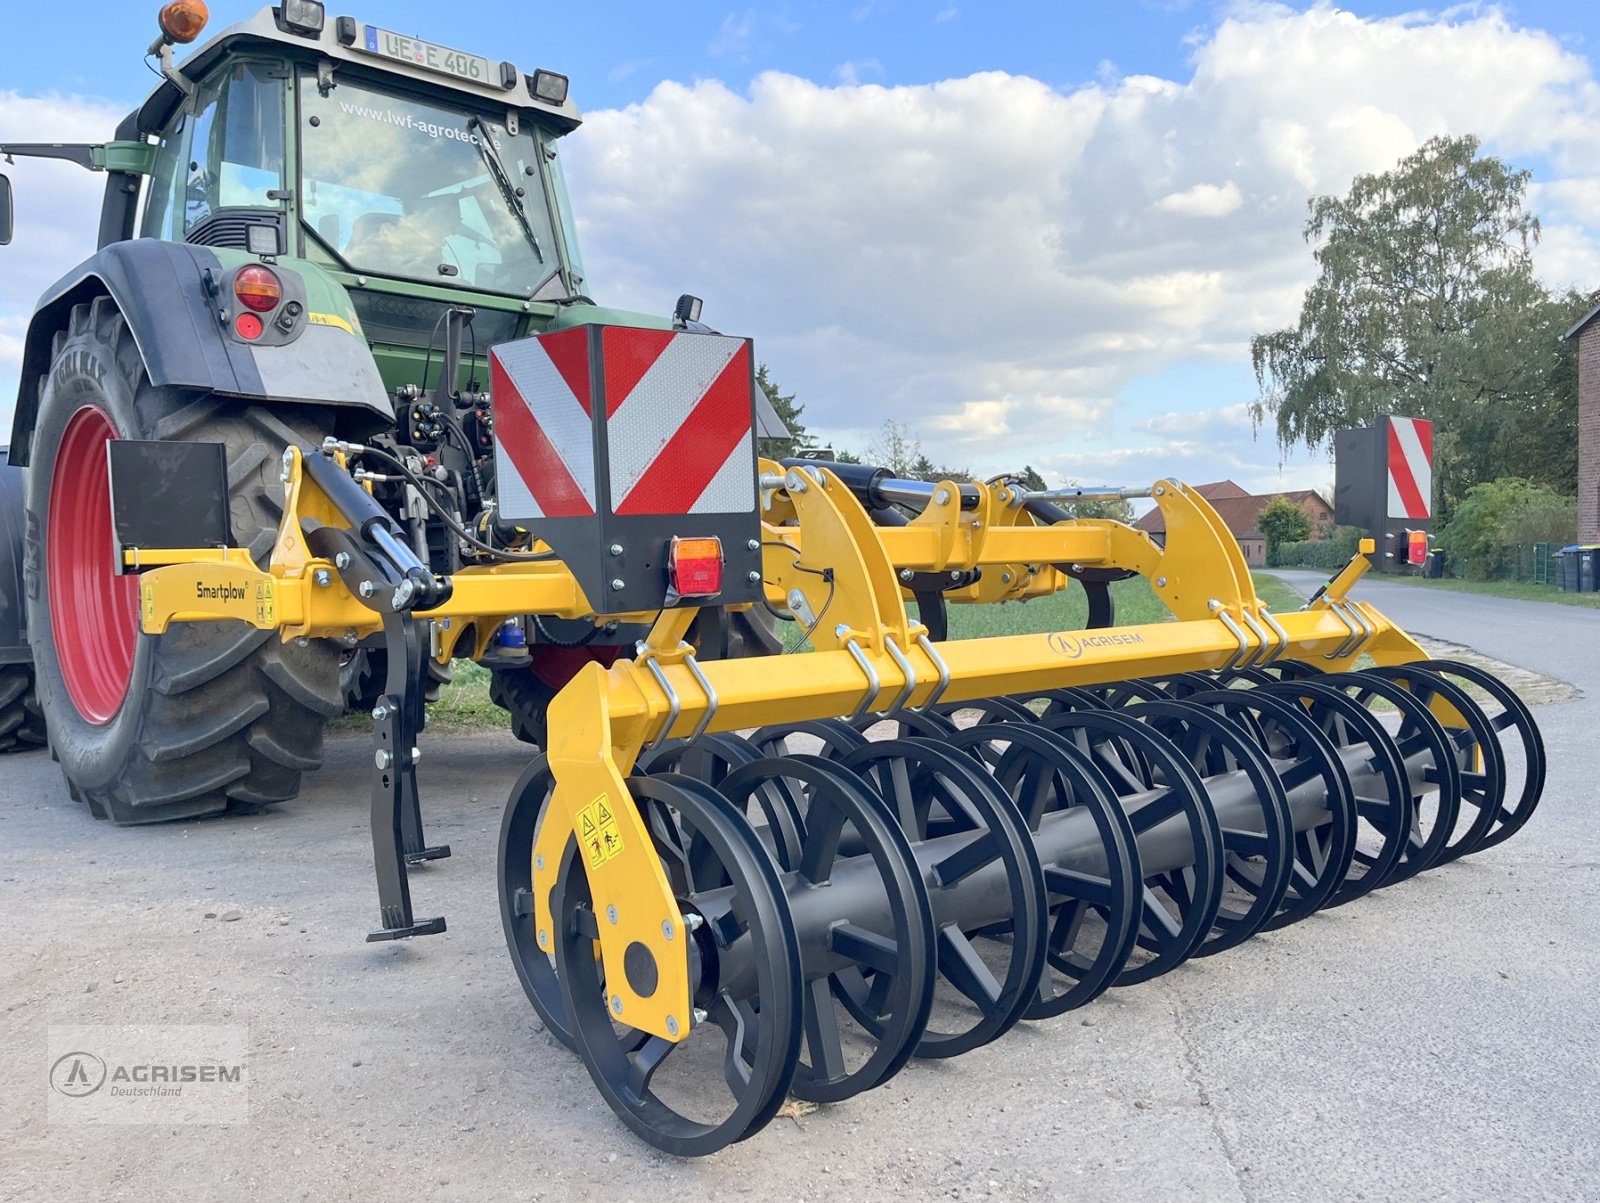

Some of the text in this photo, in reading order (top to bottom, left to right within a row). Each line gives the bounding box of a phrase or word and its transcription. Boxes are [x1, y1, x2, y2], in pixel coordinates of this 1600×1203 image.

[385, 34, 480, 79] UE E 406
[196, 581, 245, 603] Smartplow
[1081, 633, 1145, 648] AGRISEM
